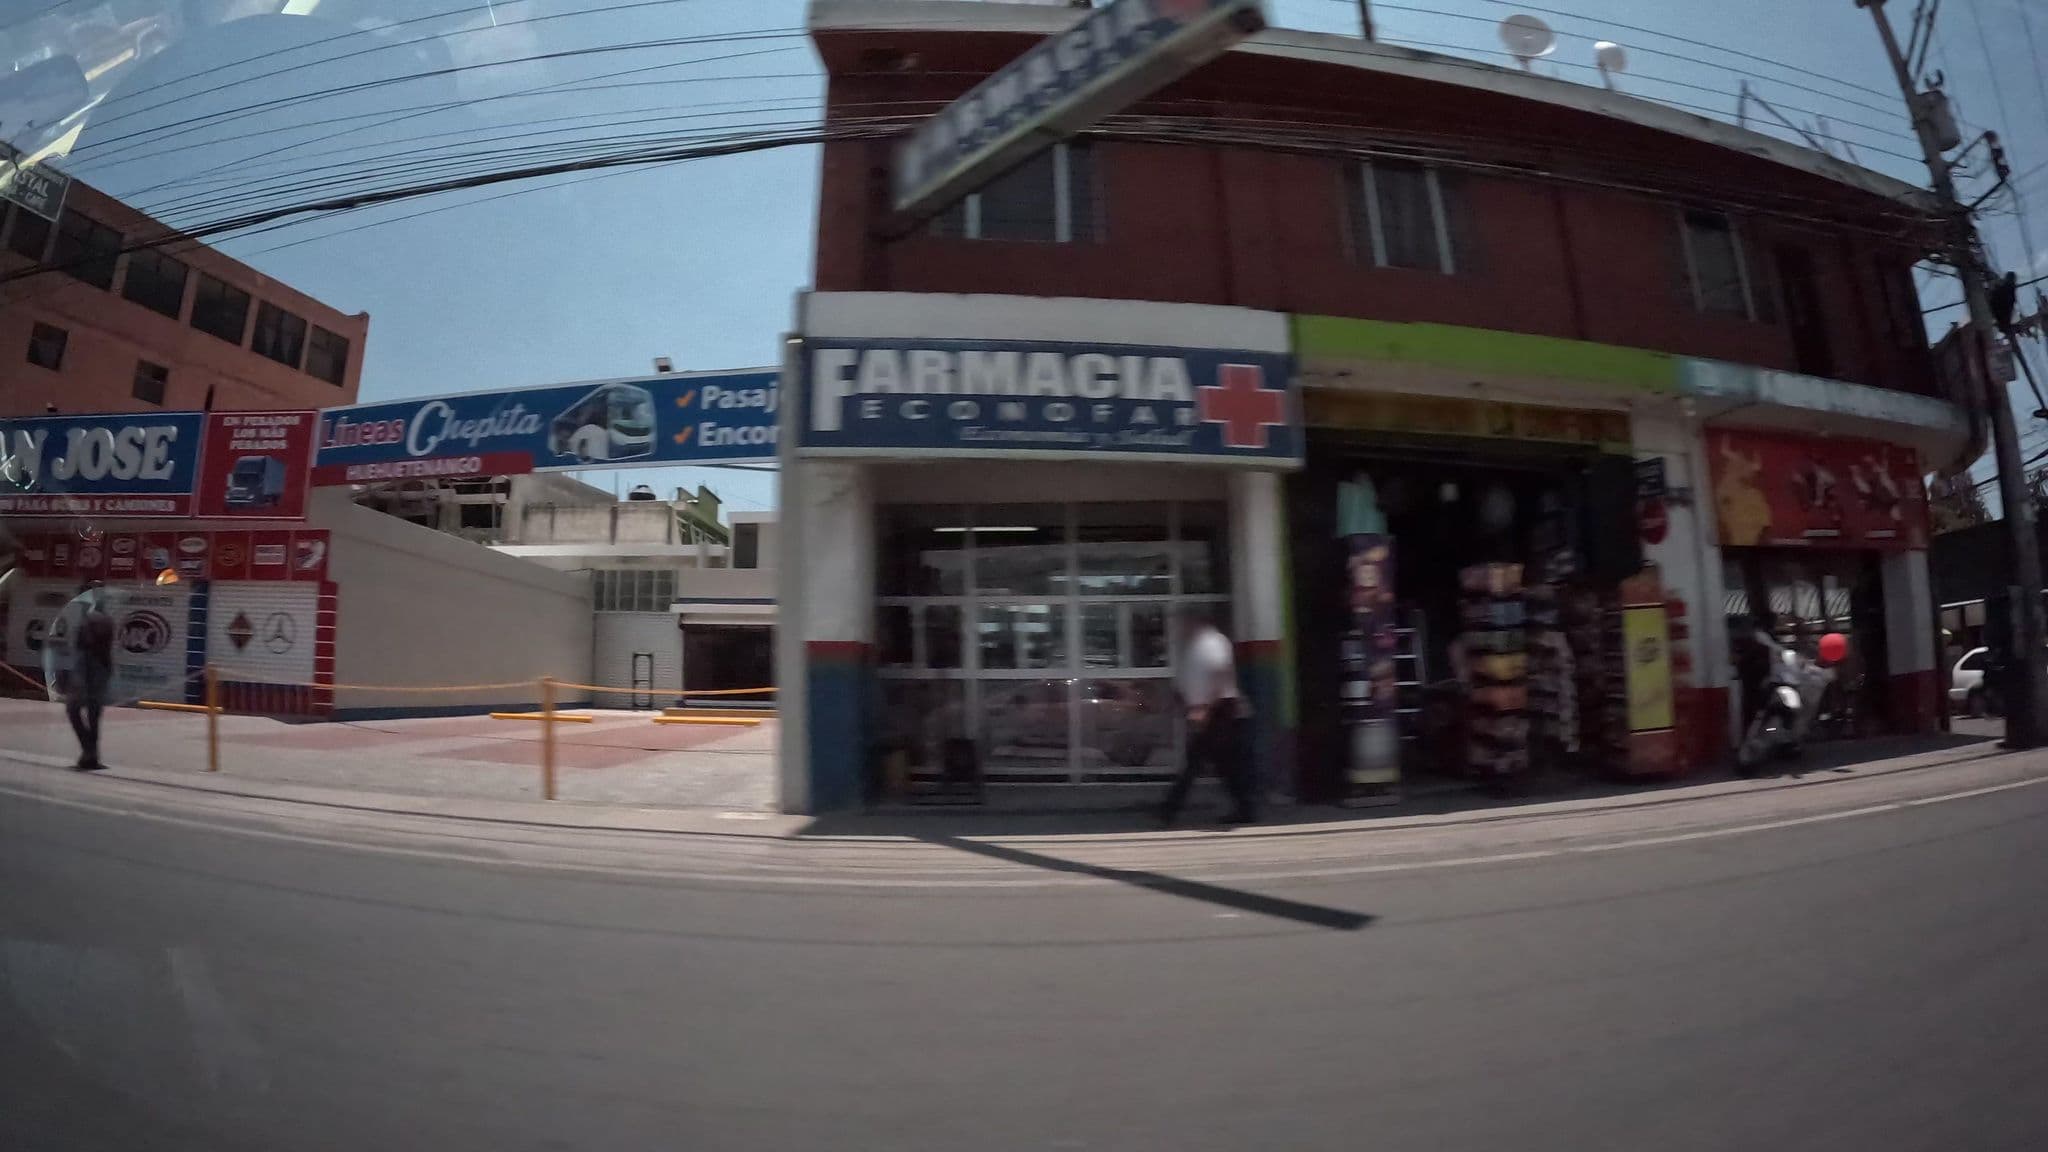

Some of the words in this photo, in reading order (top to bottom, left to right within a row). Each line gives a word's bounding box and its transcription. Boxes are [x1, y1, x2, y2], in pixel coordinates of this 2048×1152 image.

[810, 348, 1194, 432] FARMACIA
[52, 426, 178, 481] JOSE
[407, 401, 543, 457] Chepita
